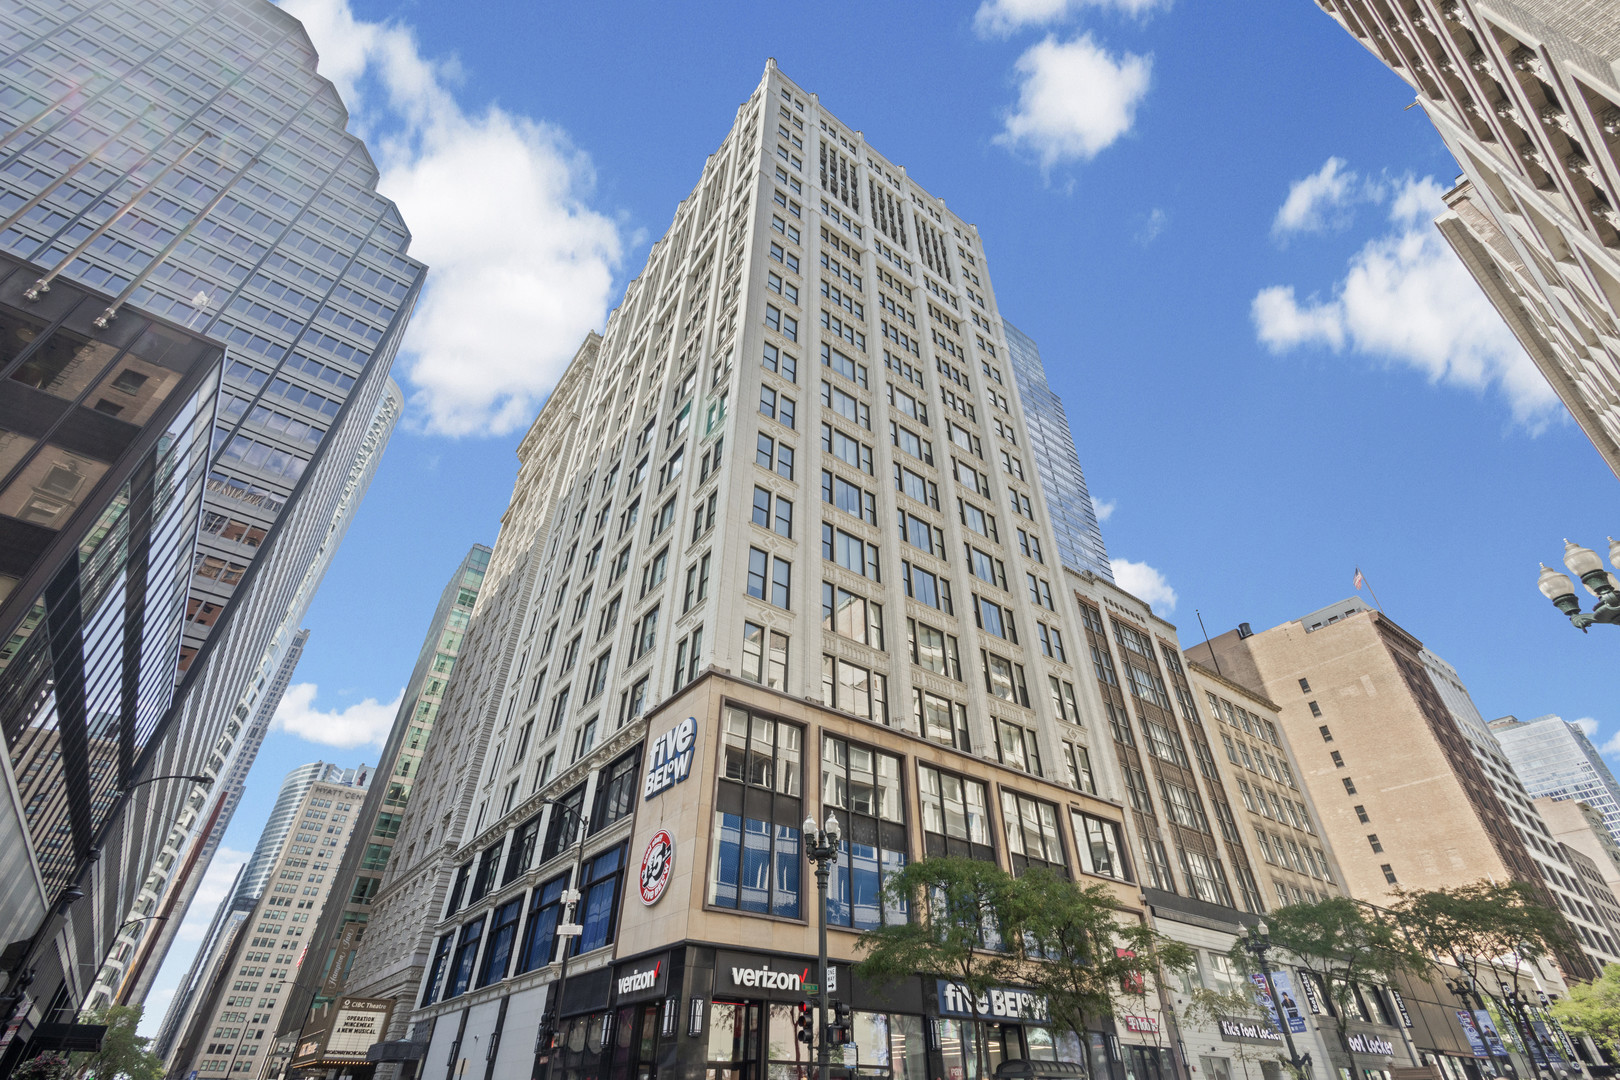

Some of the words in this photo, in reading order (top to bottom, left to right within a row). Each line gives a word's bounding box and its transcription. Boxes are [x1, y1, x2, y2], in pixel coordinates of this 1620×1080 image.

[651, 718, 695, 771] five
[645, 750, 692, 799] BELOW
[315, 786, 343, 797] HYATT
[329, 952, 347, 989] Hampton
[343, 929, 354, 950] Inn
[618, 969, 656, 994] verizon
[732, 965, 800, 991] verizon
[1240, 1023, 1259, 1038] Foot
[1346, 1034, 1367, 1052] oot
[1362, 1034, 1395, 1055] Locker
